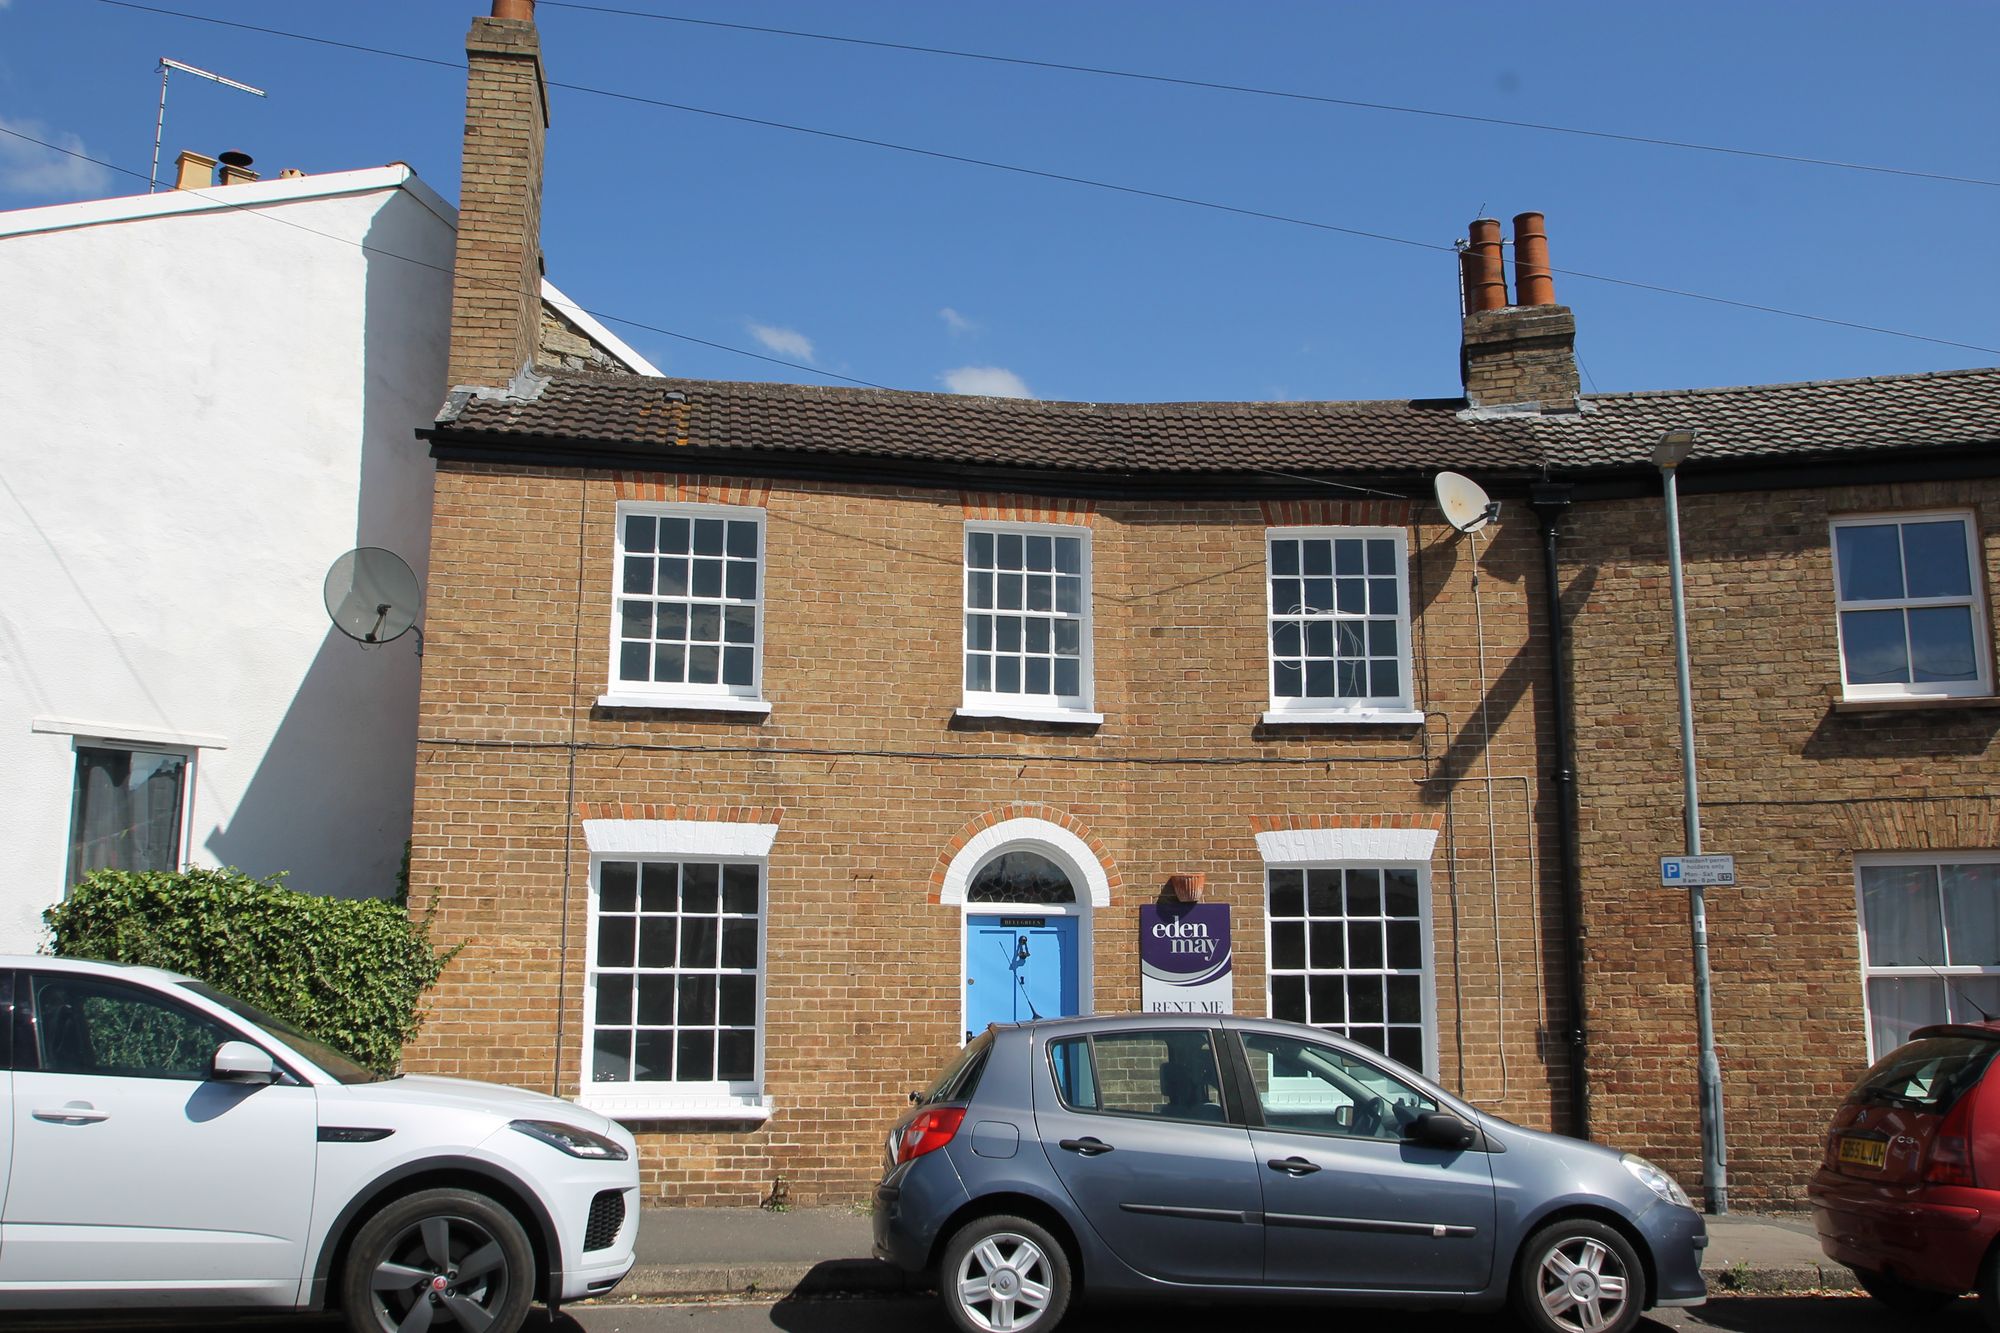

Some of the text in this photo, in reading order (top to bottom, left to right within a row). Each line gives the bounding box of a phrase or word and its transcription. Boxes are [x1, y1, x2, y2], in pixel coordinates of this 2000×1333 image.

[1667, 864, 1678, 877] P
[1152, 915, 1209, 939] eden
[1170, 938, 1220, 961] may
[1152, 1001, 1224, 1014] RENT ME
[1897, 1135, 1915, 1144] C3
